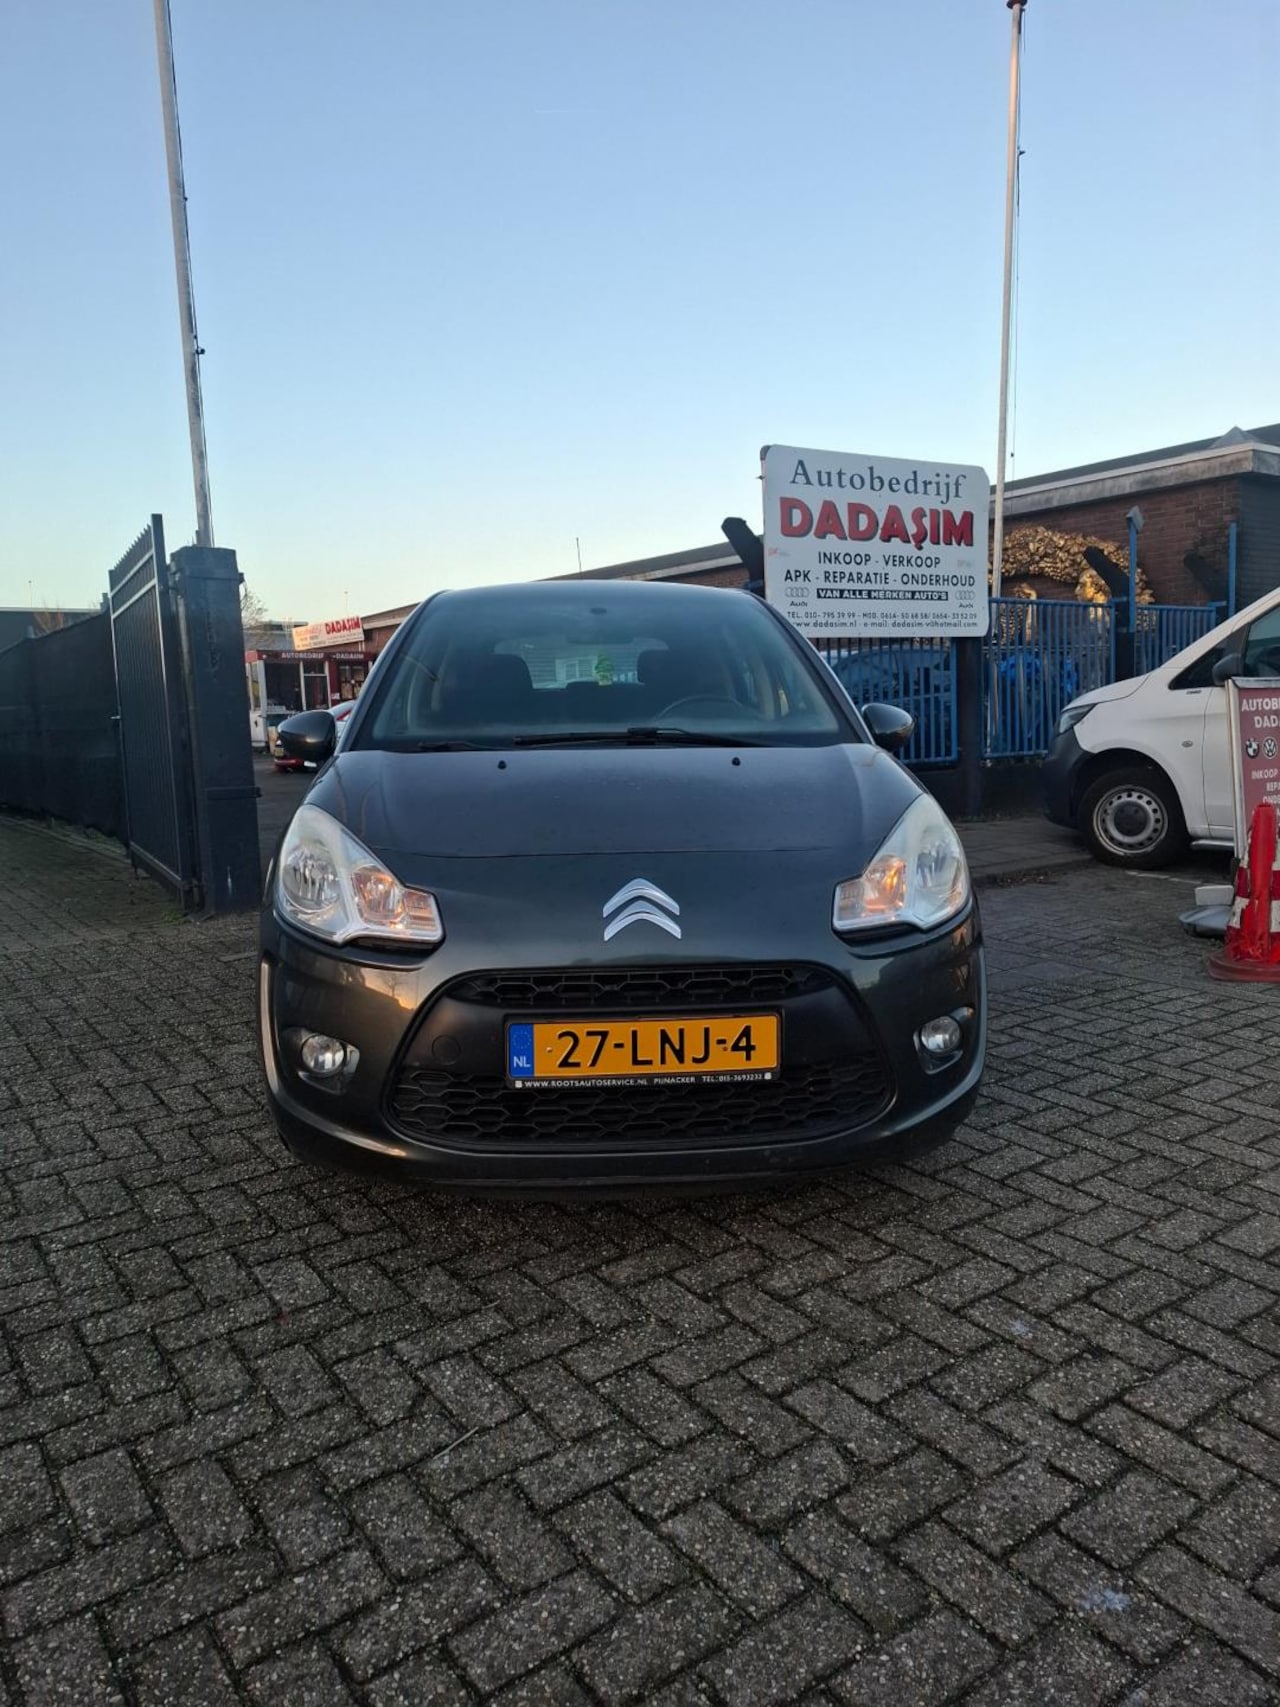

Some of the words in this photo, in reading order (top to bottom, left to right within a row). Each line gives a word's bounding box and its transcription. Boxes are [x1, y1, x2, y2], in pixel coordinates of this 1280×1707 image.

[790, 459, 967, 505] Autobedrijf
[818, 551, 871, 566] INKOOP
[882, 554, 941, 569] VERKOOP
[784, 569, 812, 583] APK
[824, 570, 890, 585] REPARATIE
[901, 573, 975, 587] ONDERHOUD
[819, 589, 840, 598] VAN
[843, 590, 869, 598] ALLE
[871, 590, 912, 599] MERKEN
[914, 591, 947, 600] AUTO'S
[787, 611, 803, 619] TEL.
[1241, 697, 1280, 712] AUTOB
[1254, 715, 1280, 728] DAD
[557, 1025, 756, 1068] 27-LNJ-4
[513, 1055, 531, 1067] NL
